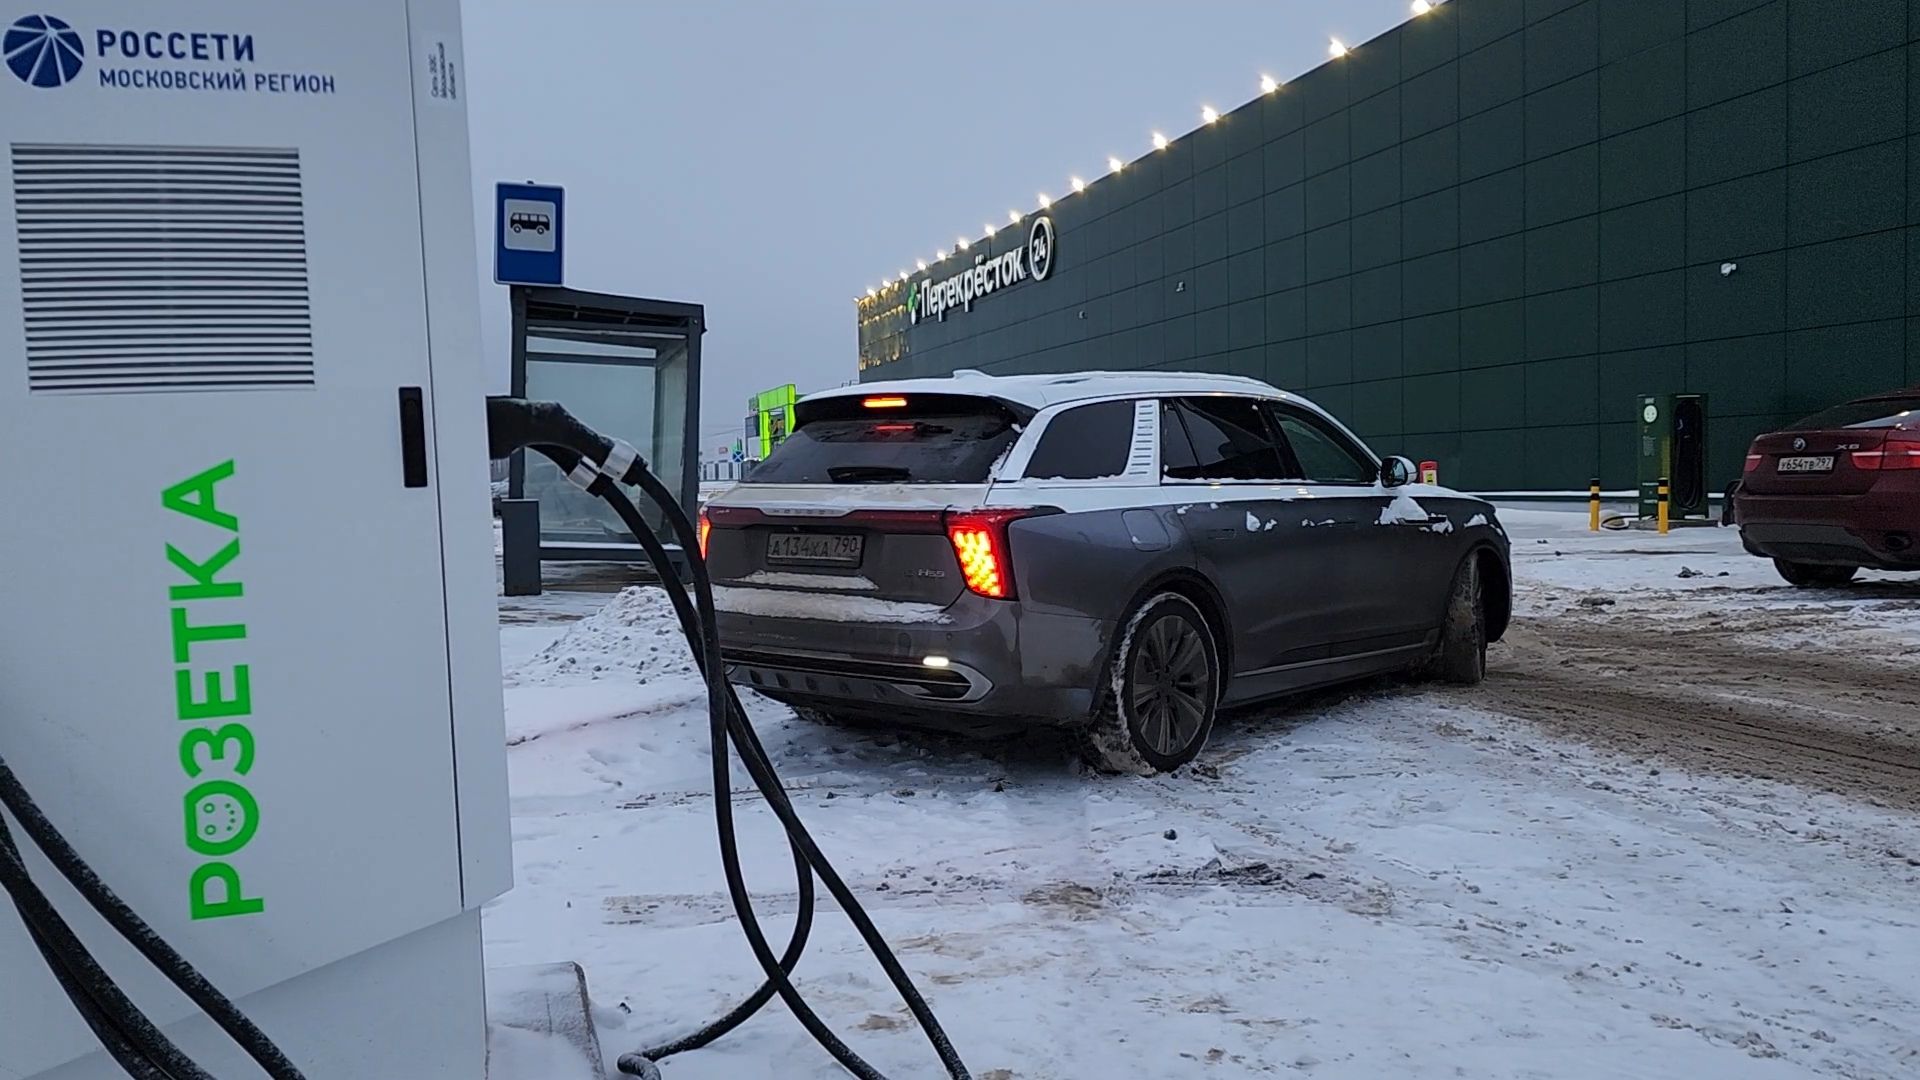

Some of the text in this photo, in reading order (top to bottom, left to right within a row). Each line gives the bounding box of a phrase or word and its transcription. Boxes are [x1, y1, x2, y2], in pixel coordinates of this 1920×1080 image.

[96, 29, 254, 62] РОССЕТИ
[99, 68, 335, 93] МОСКОВСКИЙ РЕГИОН
[921, 235, 1047, 322] Перекрёсток 24
[162, 458, 264, 920] РОЗЕТКА
